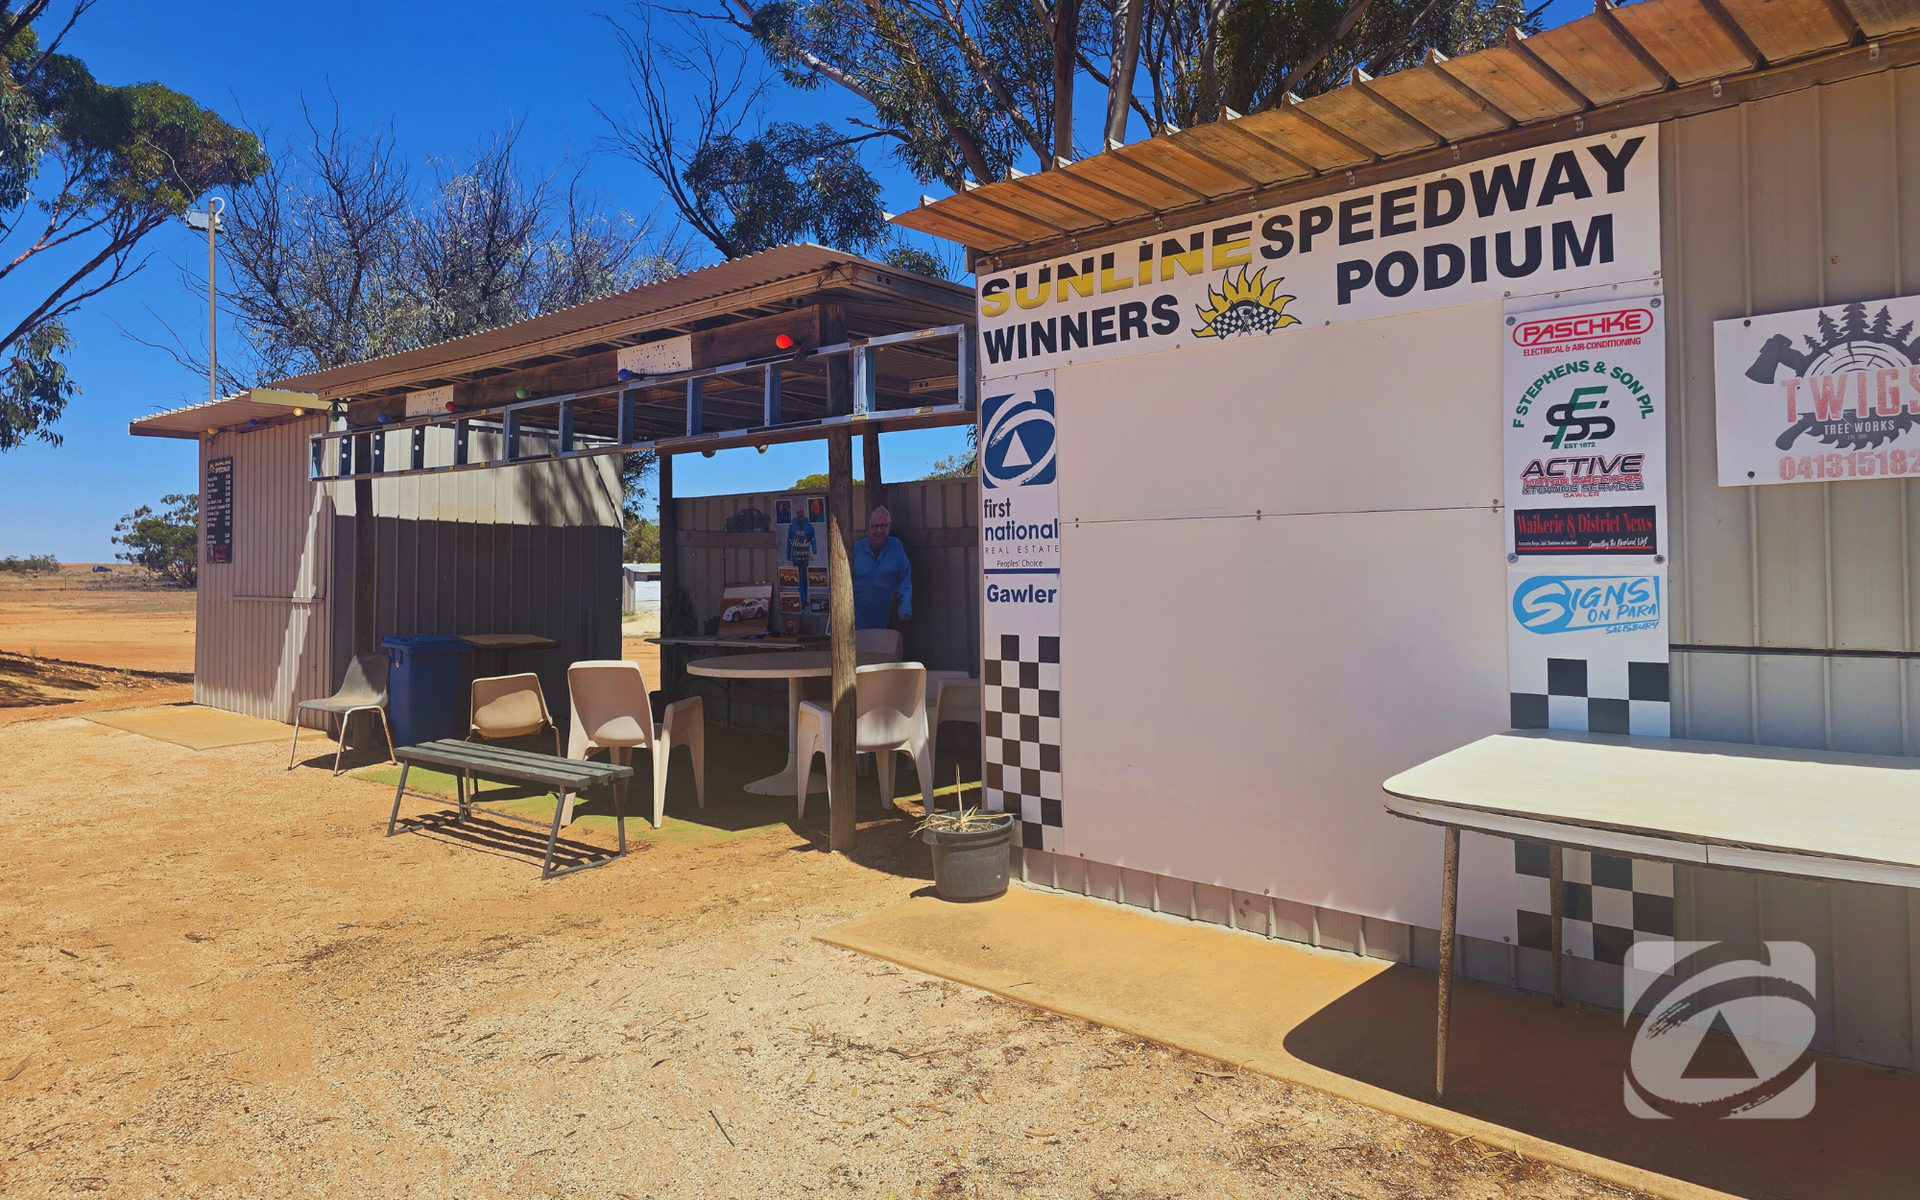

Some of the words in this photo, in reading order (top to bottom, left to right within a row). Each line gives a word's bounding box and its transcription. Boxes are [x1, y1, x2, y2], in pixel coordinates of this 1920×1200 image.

[981, 221, 1253, 317] SUNLINE
[1259, 136, 1646, 260] SPEEDWAY
[982, 294, 1180, 365] WINNERS
[1336, 213, 1614, 306] PODIUM
[1523, 310, 1641, 344] PASCHKE
[1523, 345, 1564, 357] ELECTRICAL
[1565, 344, 1571, 352] &
[1572, 337, 1641, 352] AIR-CONDITIONING
[1593, 360, 1607, 374] &
[1515, 360, 1590, 416] STEPHENS
[1609, 366, 1645, 395] SON
[1636, 393, 1655, 420] P/L
[1512, 418, 1525, 428] F
[1824, 423, 1850, 435] TREE
[1854, 420, 1895, 433] WORKS
[1521, 454, 1645, 478] ACTIVE
[1523, 476, 1569, 487] MOTOR
[1571, 474, 1643, 485] WRECKERS
[1580, 482, 1644, 492] SERVICES
[984, 498, 1011, 518] first
[985, 518, 1059, 541] national
[1517, 514, 1565, 534] Waikerie
[1566, 514, 1576, 539] &
[1578, 512, 1620, 533] District
[1623, 512, 1653, 532] News
[985, 546, 1010, 554] REAL
[1017, 545, 1059, 553] ESTATE
[996, 559, 1021, 569] Peoples'
[1022, 559, 1043, 567] Choice
[987, 584, 1057, 603] Gawler
[1521, 578, 1650, 627] SIGNS
[1587, 609, 1610, 622] ON
[1616, 603, 1657, 619] PARA
[1605, 621, 1660, 634] SALISBURY
